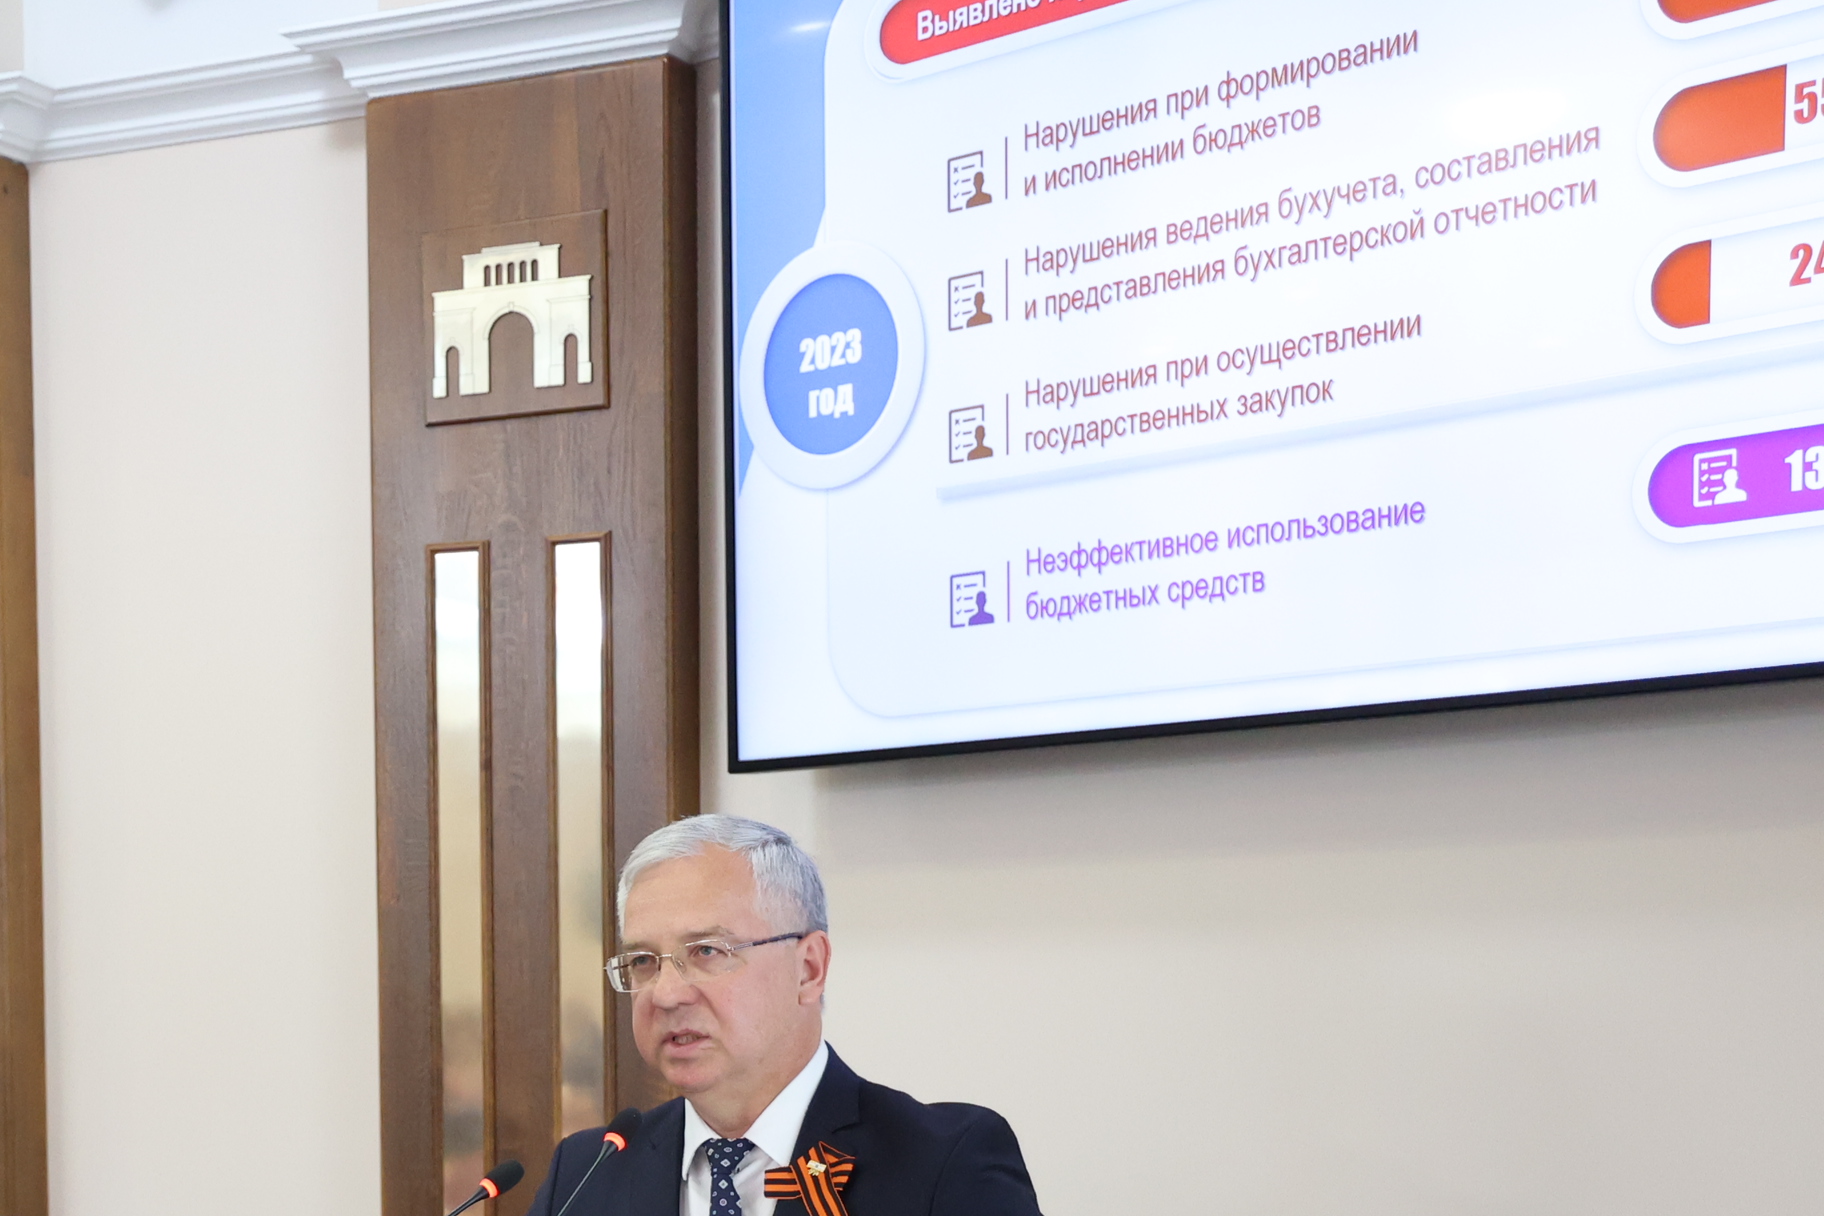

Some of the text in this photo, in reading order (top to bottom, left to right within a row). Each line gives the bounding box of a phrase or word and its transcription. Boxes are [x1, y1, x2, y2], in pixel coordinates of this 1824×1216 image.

[1024, 29, 1419, 153] Нарушения при формировании
[1023, 104, 1322, 198] и исполнении бюджетов
[1024, 125, 1601, 278] Нарушения ведения бухучета, составления
[1024, 178, 1598, 322] и представления бухгалтерской отчетности
[799, 328, 862, 373] 2023
[1024, 313, 1422, 411] Нарушения при осуществлении
[808, 382, 854, 419] год
[1024, 378, 1335, 455] государственных закупок
[1025, 500, 1427, 578] Неэффективное использование
[1025, 570, 1266, 623] бюджетных средств
